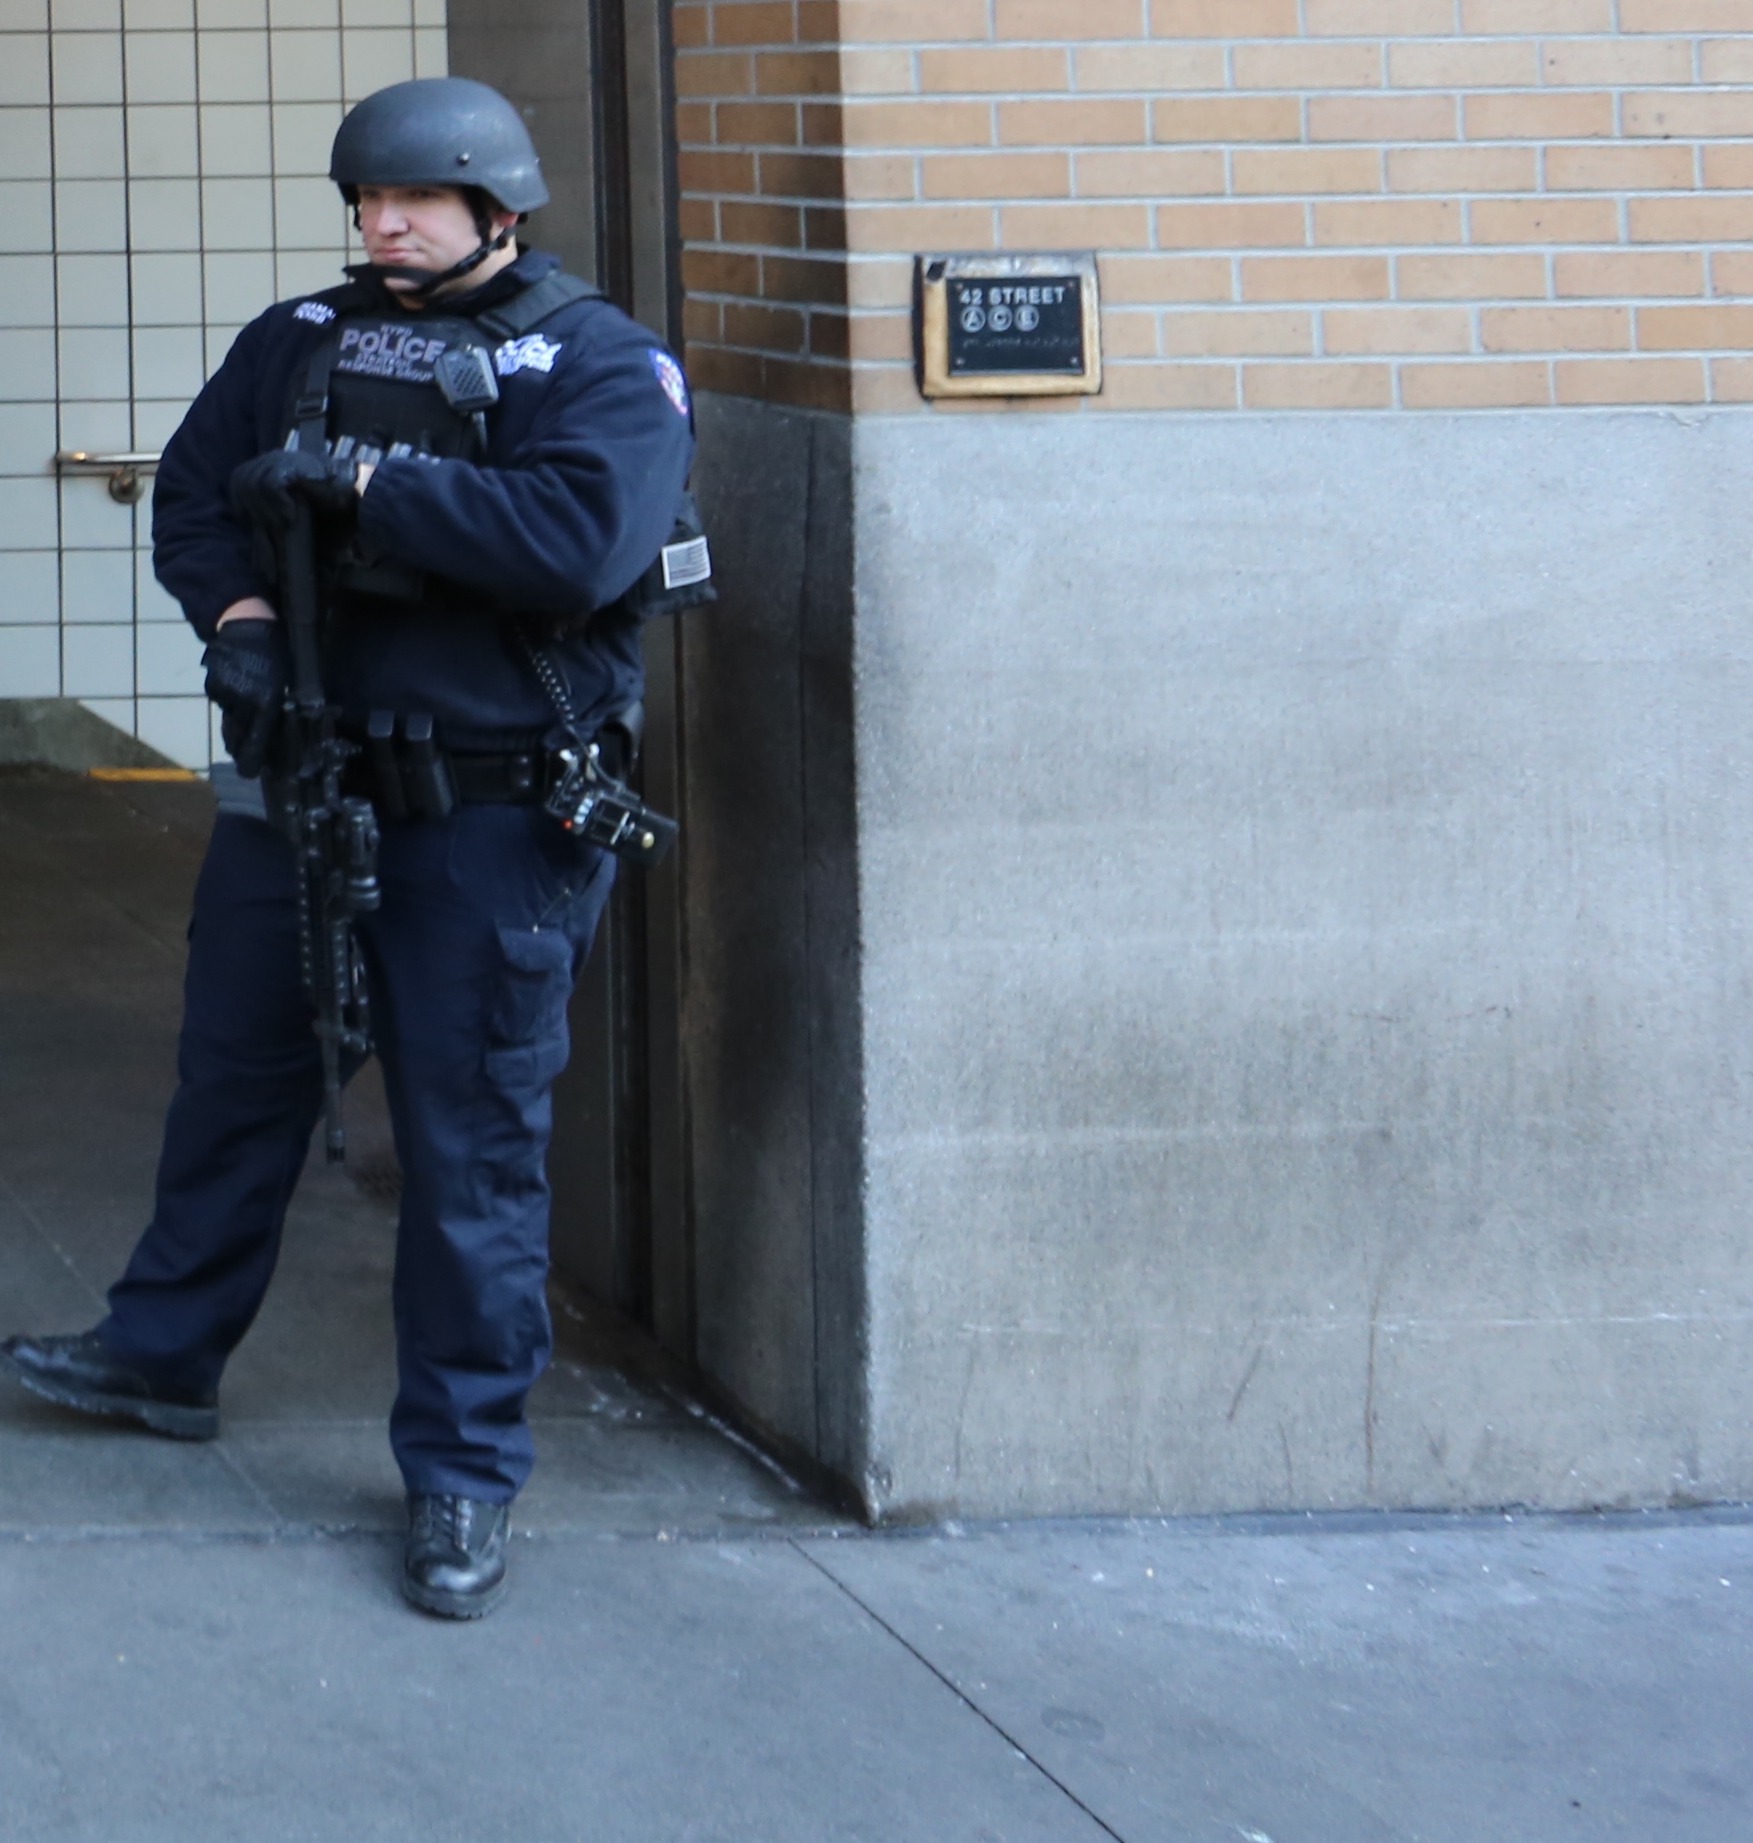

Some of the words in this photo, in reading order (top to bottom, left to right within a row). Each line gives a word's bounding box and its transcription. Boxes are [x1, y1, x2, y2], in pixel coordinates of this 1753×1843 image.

[959, 288, 984, 305] 42
[988, 286, 1067, 305] STREET
[339, 328, 446, 363] POLICE
